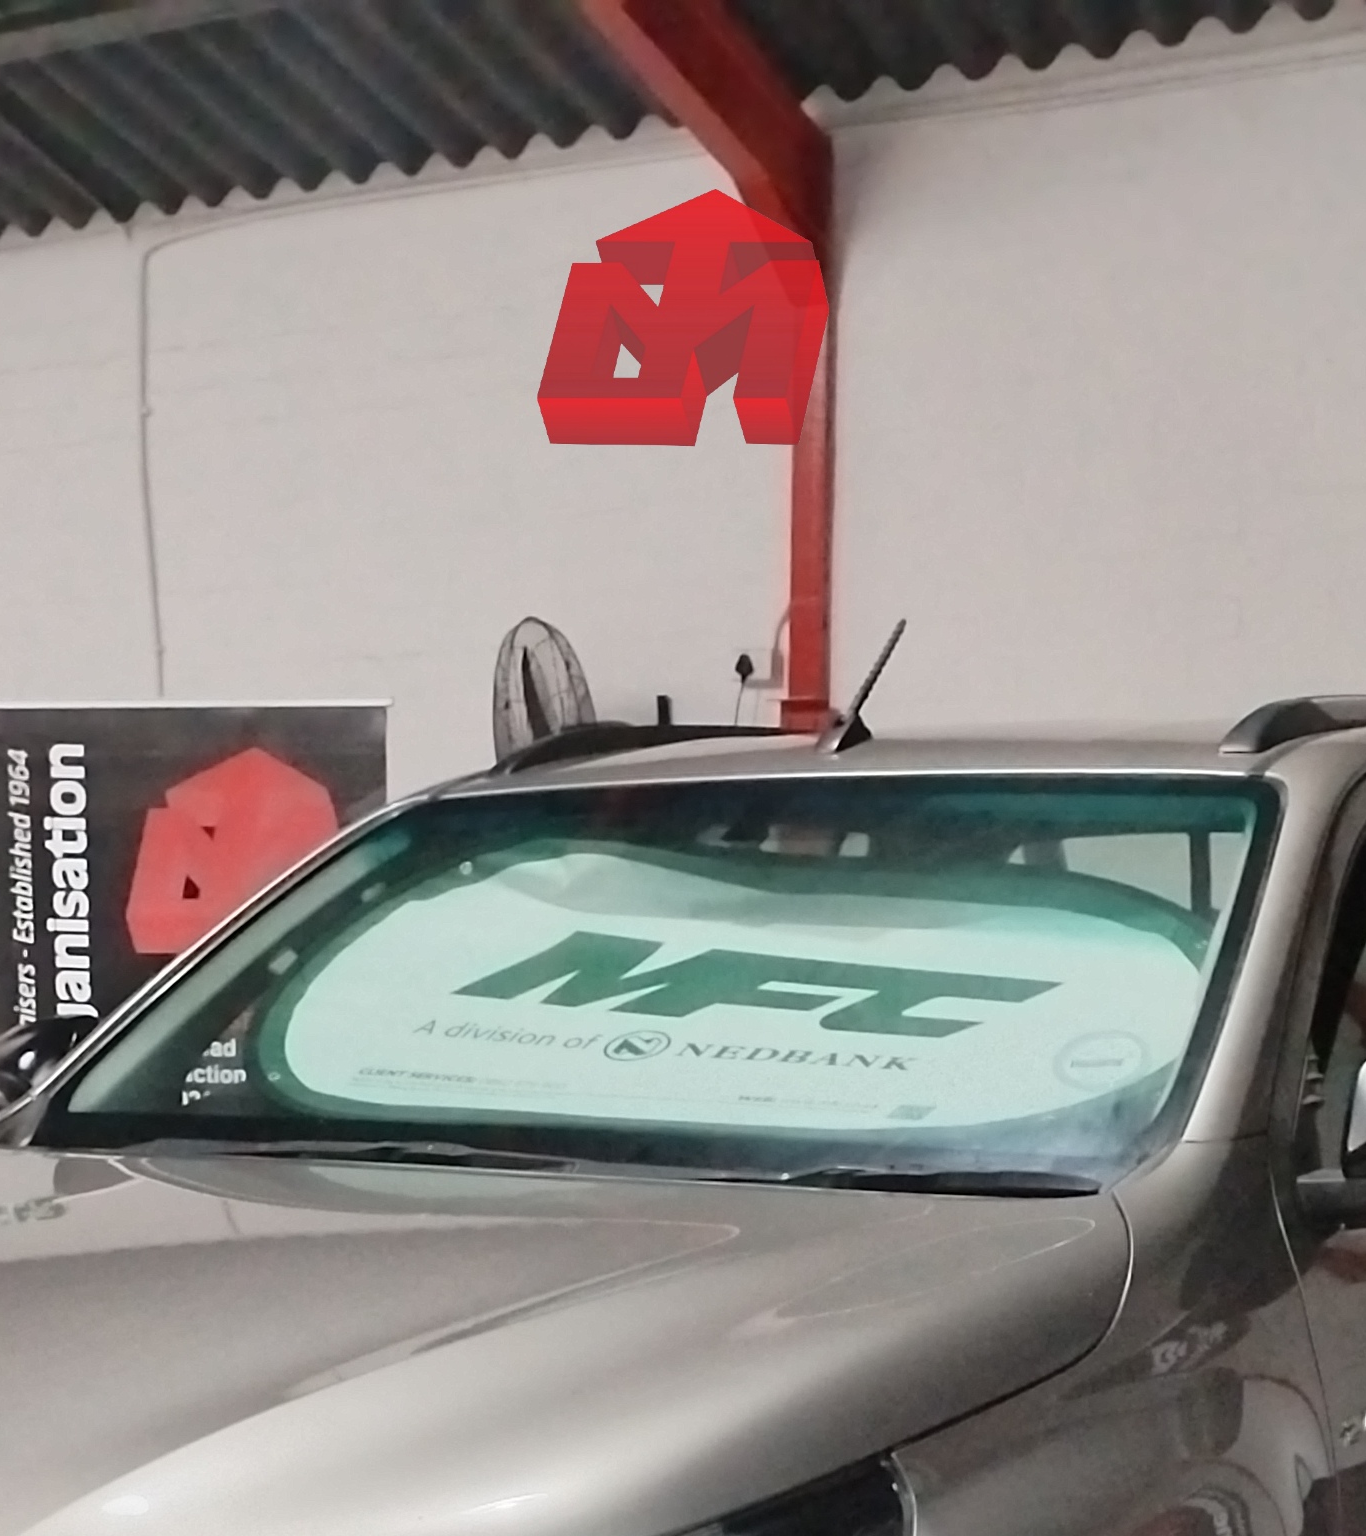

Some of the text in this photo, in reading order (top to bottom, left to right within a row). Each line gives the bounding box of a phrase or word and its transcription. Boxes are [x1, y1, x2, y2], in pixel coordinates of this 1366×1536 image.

[7, 748, 30, 807] 1964
[7, 812, 35, 944] Established
[449, 928, 1063, 1038] MFC
[202, 1037, 237, 1057] ad
[413, 1019, 922, 1071] A division of NEDBANK
